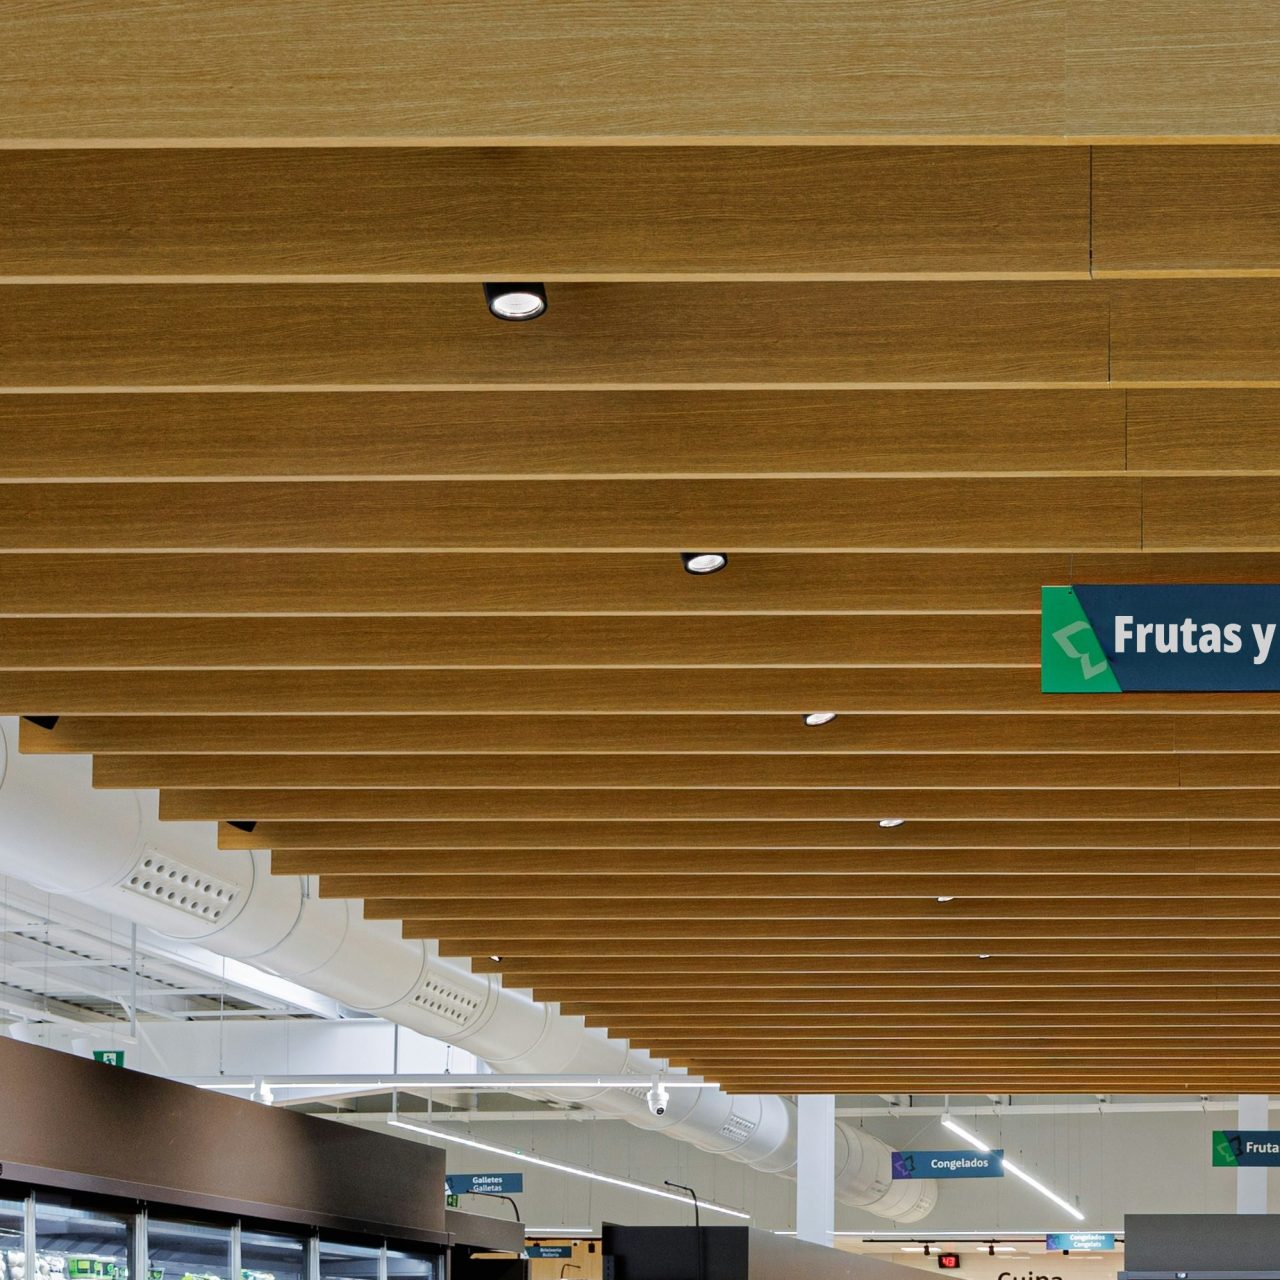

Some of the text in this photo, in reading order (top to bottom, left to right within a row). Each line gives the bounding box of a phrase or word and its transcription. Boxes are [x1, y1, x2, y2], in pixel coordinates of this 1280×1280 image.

[1114, 614, 1243, 654] Frutas
[1250, 622, 1277, 665] y
[930, 1158, 989, 1170] Congelados
[472, 1176, 503, 1184] Galletes
[473, 1184, 503, 1192] Galletas
